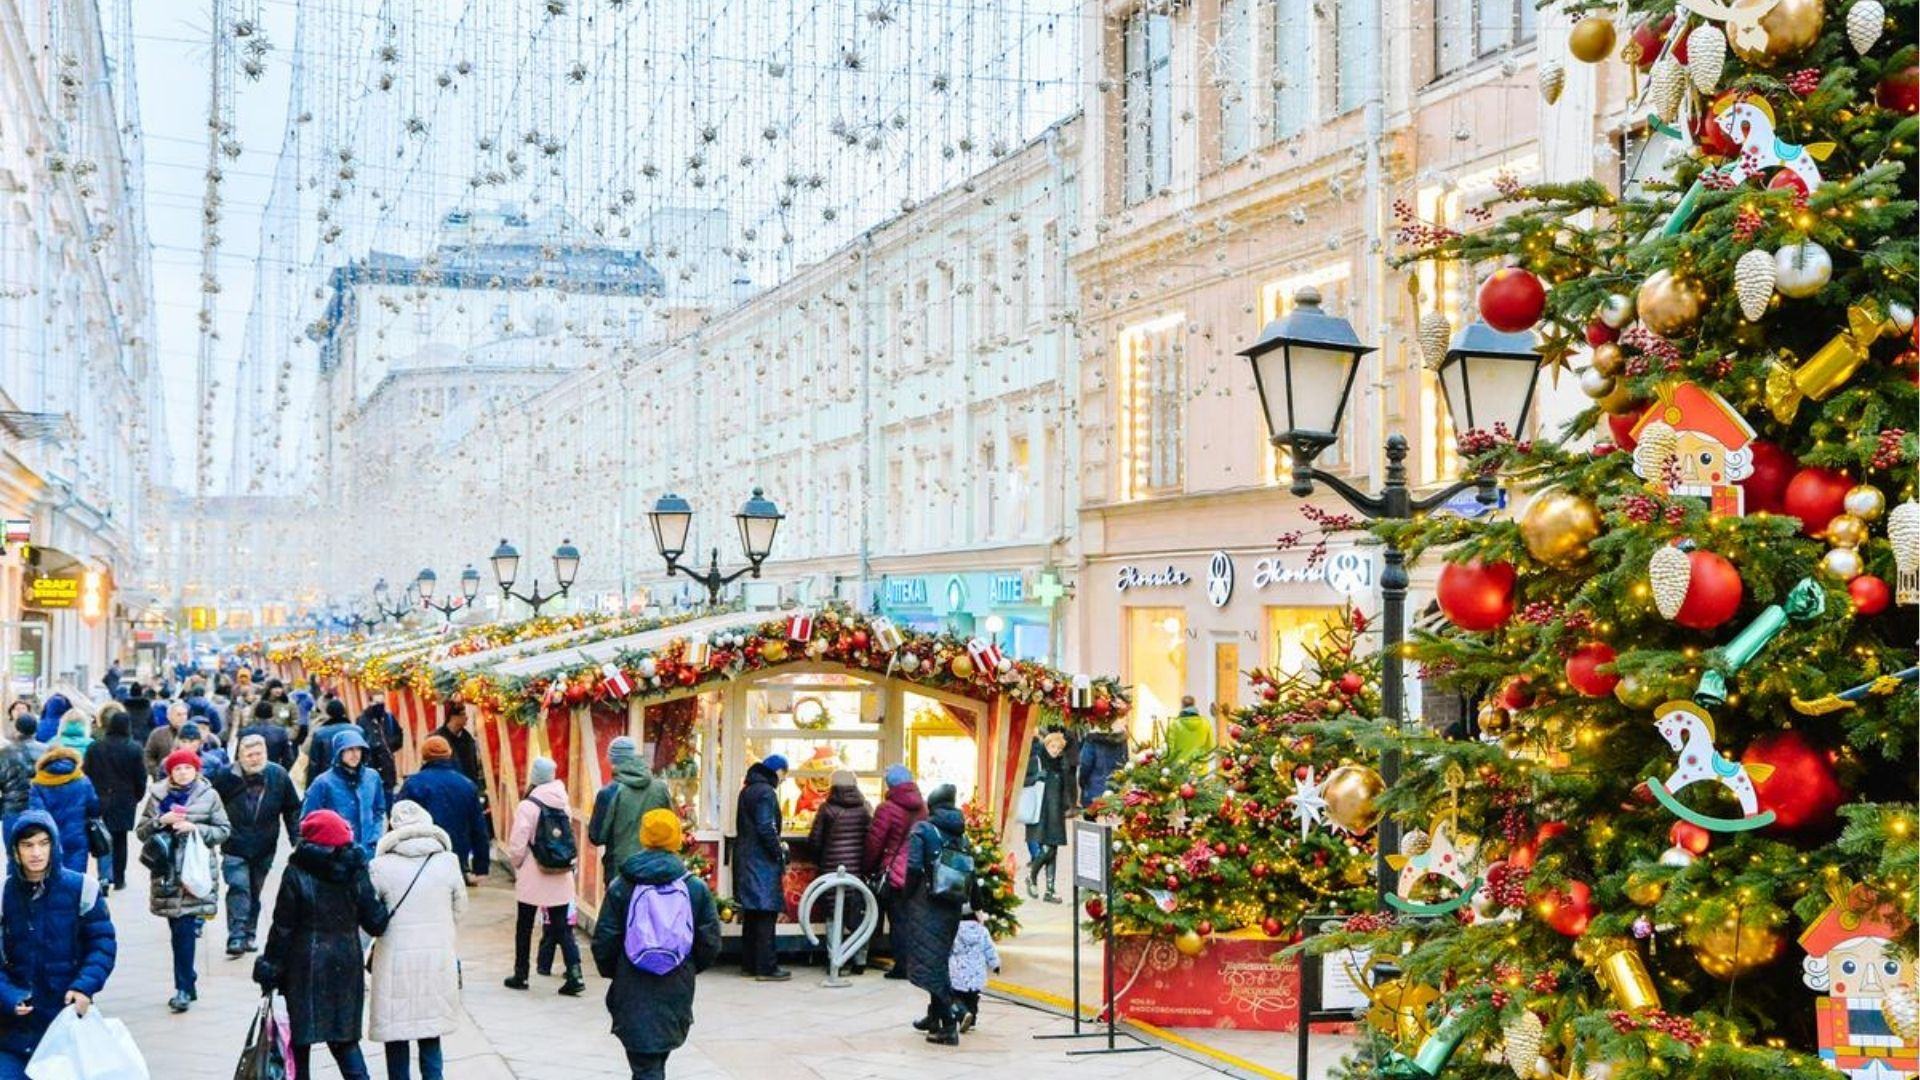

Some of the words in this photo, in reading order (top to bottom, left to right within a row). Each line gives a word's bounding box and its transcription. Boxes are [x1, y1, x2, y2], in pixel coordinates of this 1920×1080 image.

[33, 579, 77, 590] CRAFT
[1253, 558, 1323, 588] Экони
[989, 576, 1023, 602] АПТЕ
